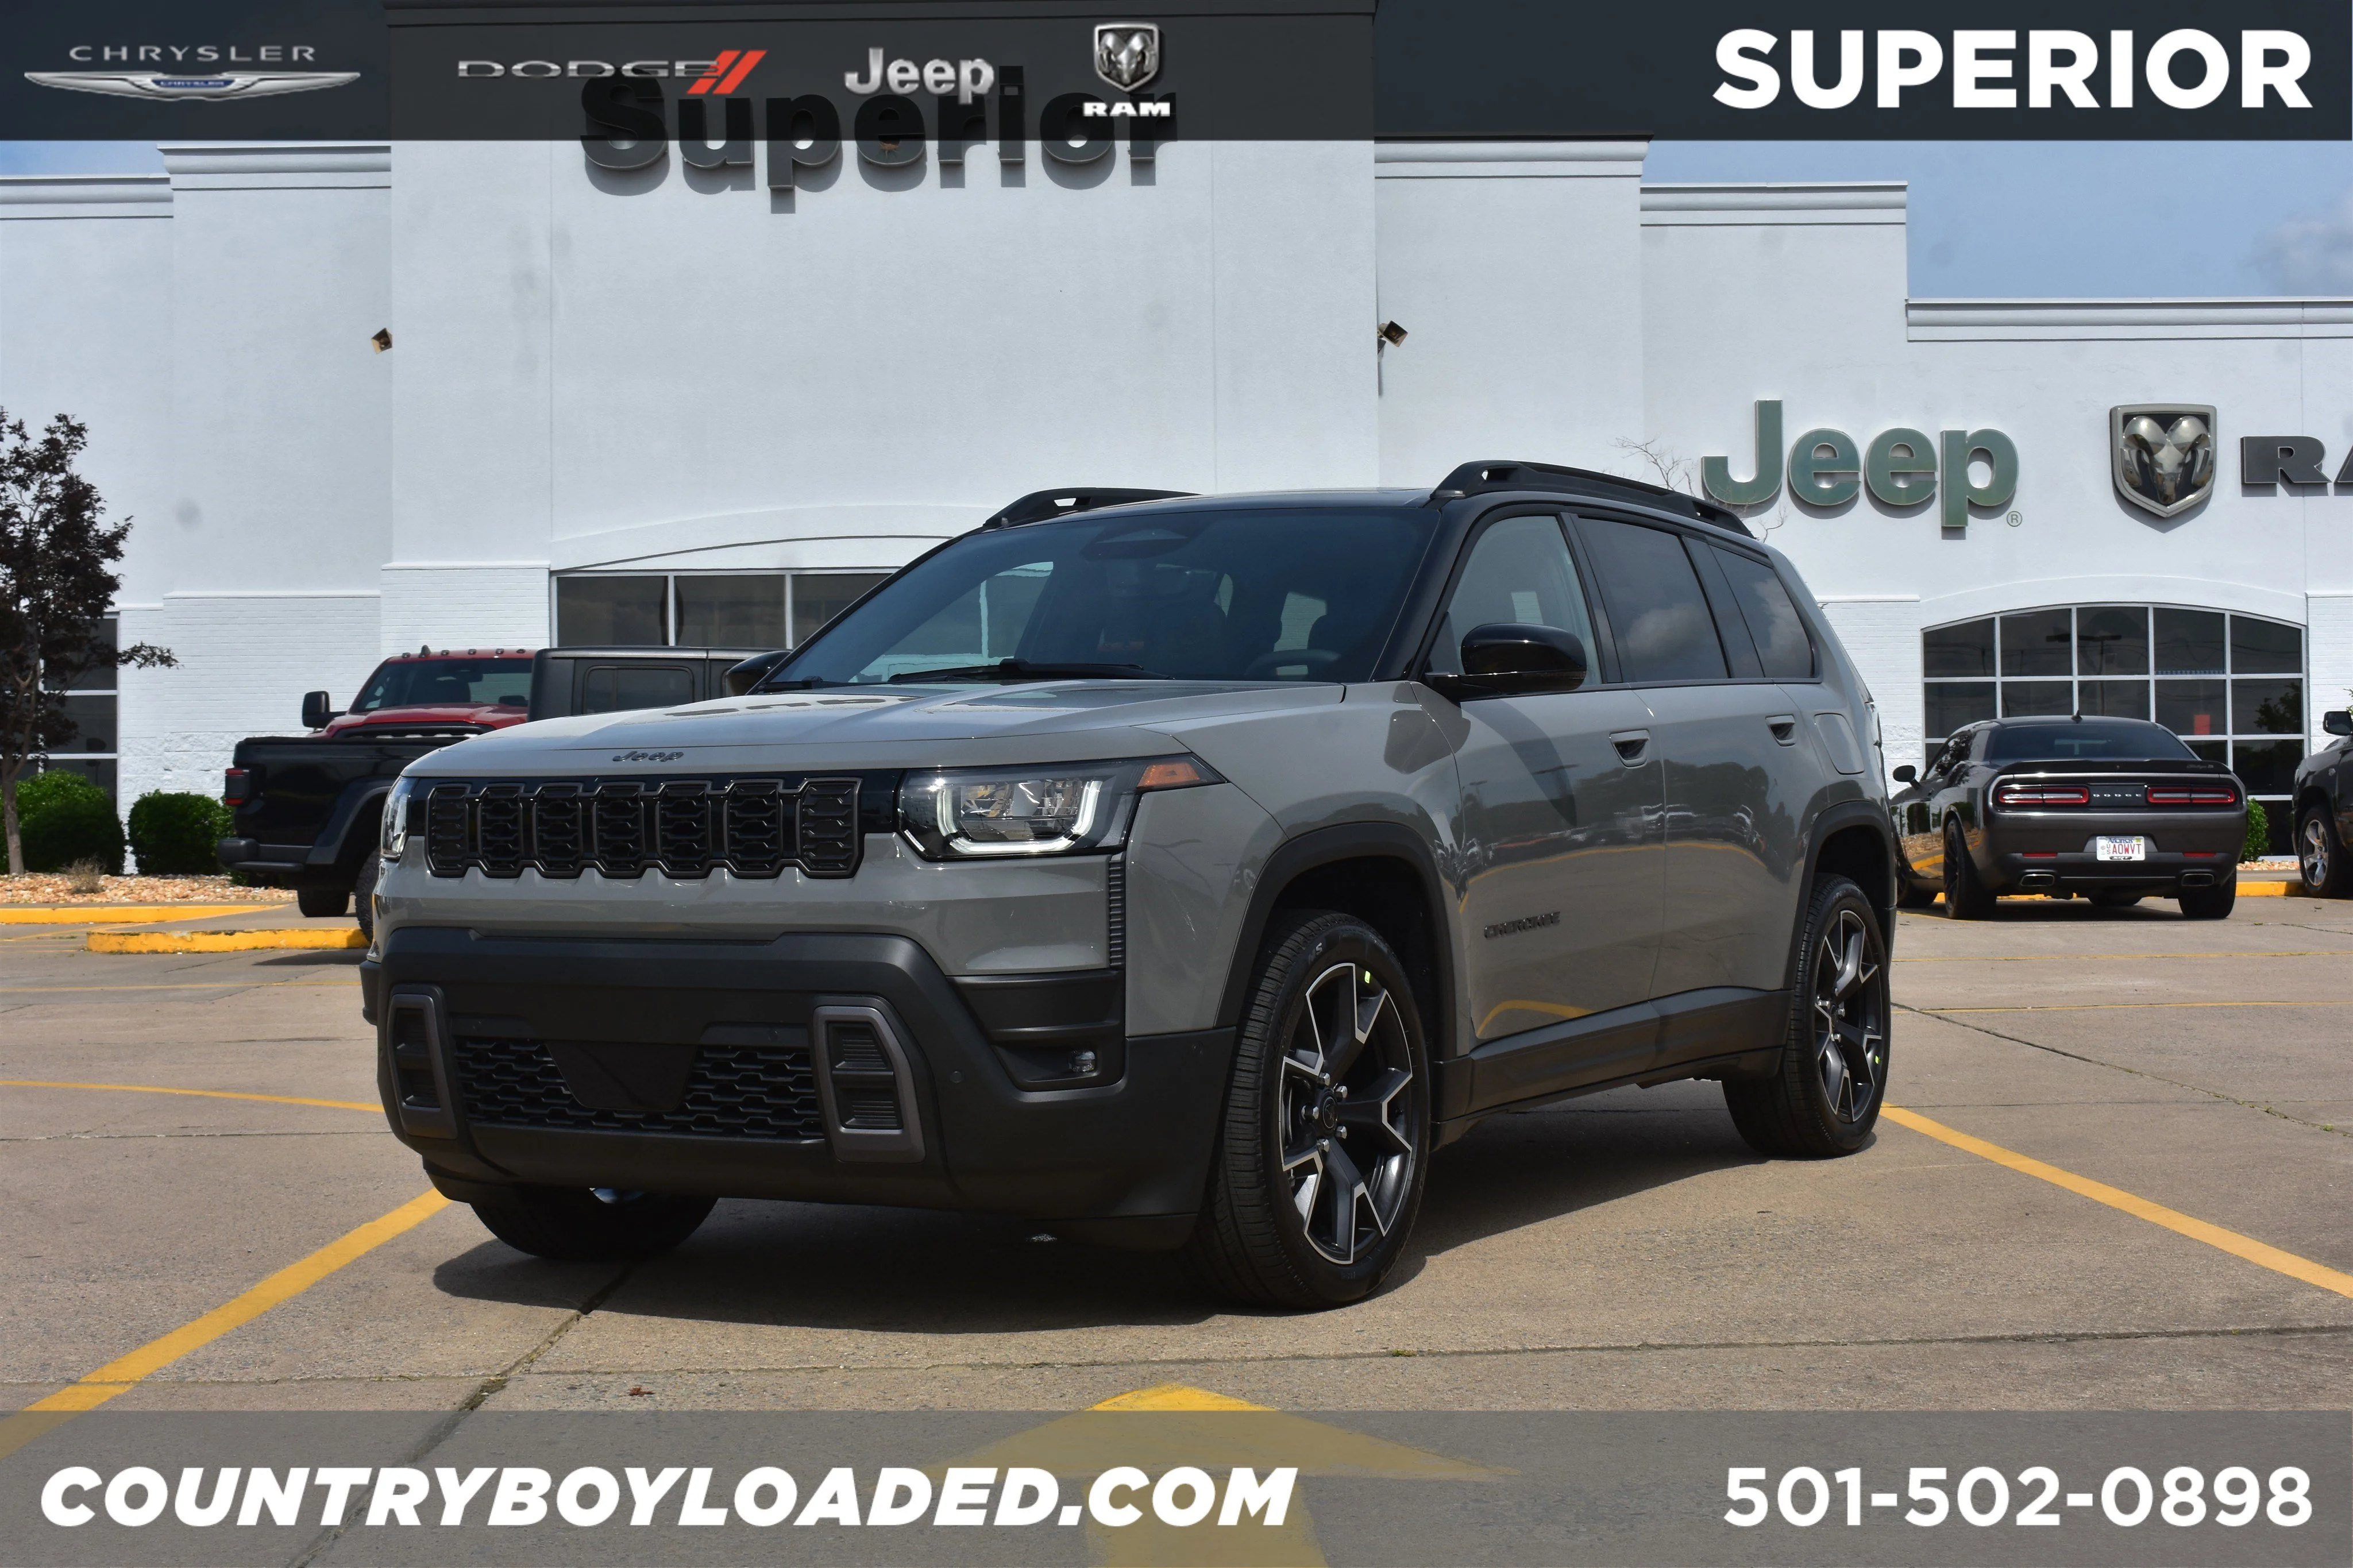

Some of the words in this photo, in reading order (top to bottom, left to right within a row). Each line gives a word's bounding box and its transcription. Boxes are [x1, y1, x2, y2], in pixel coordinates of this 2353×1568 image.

[580, 65, 1178, 190] Superior
[1702, 399, 2019, 530] Jeep
[612, 751, 684, 762] Jeep
[1484, 912, 1561, 939] CHEROKEE
